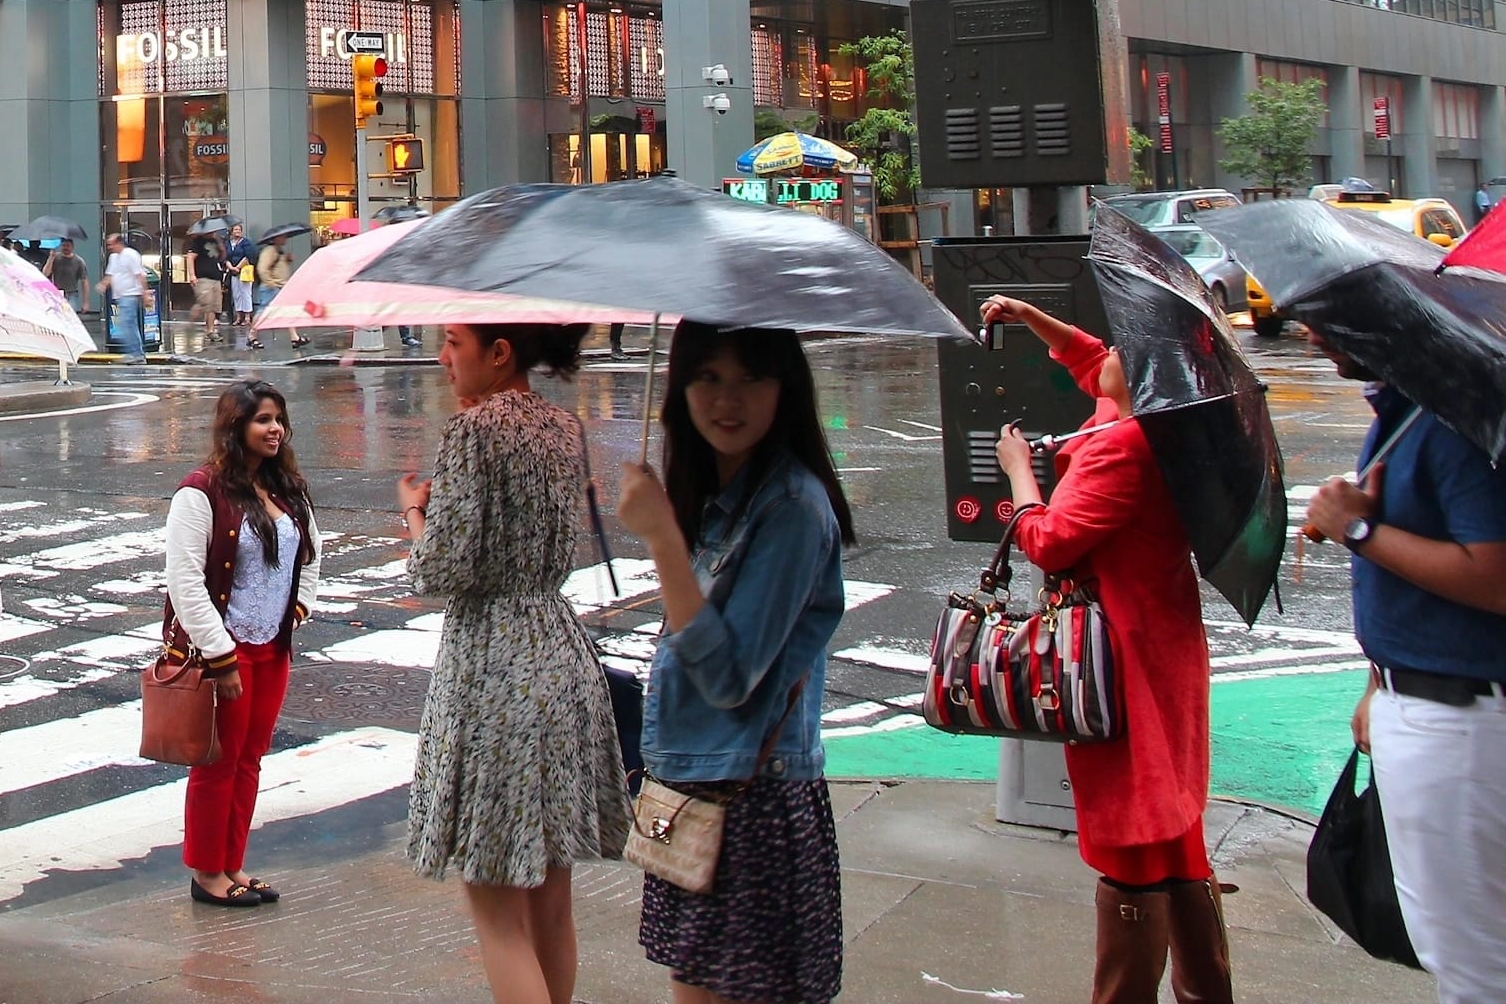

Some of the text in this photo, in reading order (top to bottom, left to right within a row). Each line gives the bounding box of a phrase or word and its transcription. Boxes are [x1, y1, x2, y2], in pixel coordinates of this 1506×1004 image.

[320, 26, 406, 62] FOIL
[757, 156, 800, 171] SABRETT
[809, 180, 839, 201] DOG
